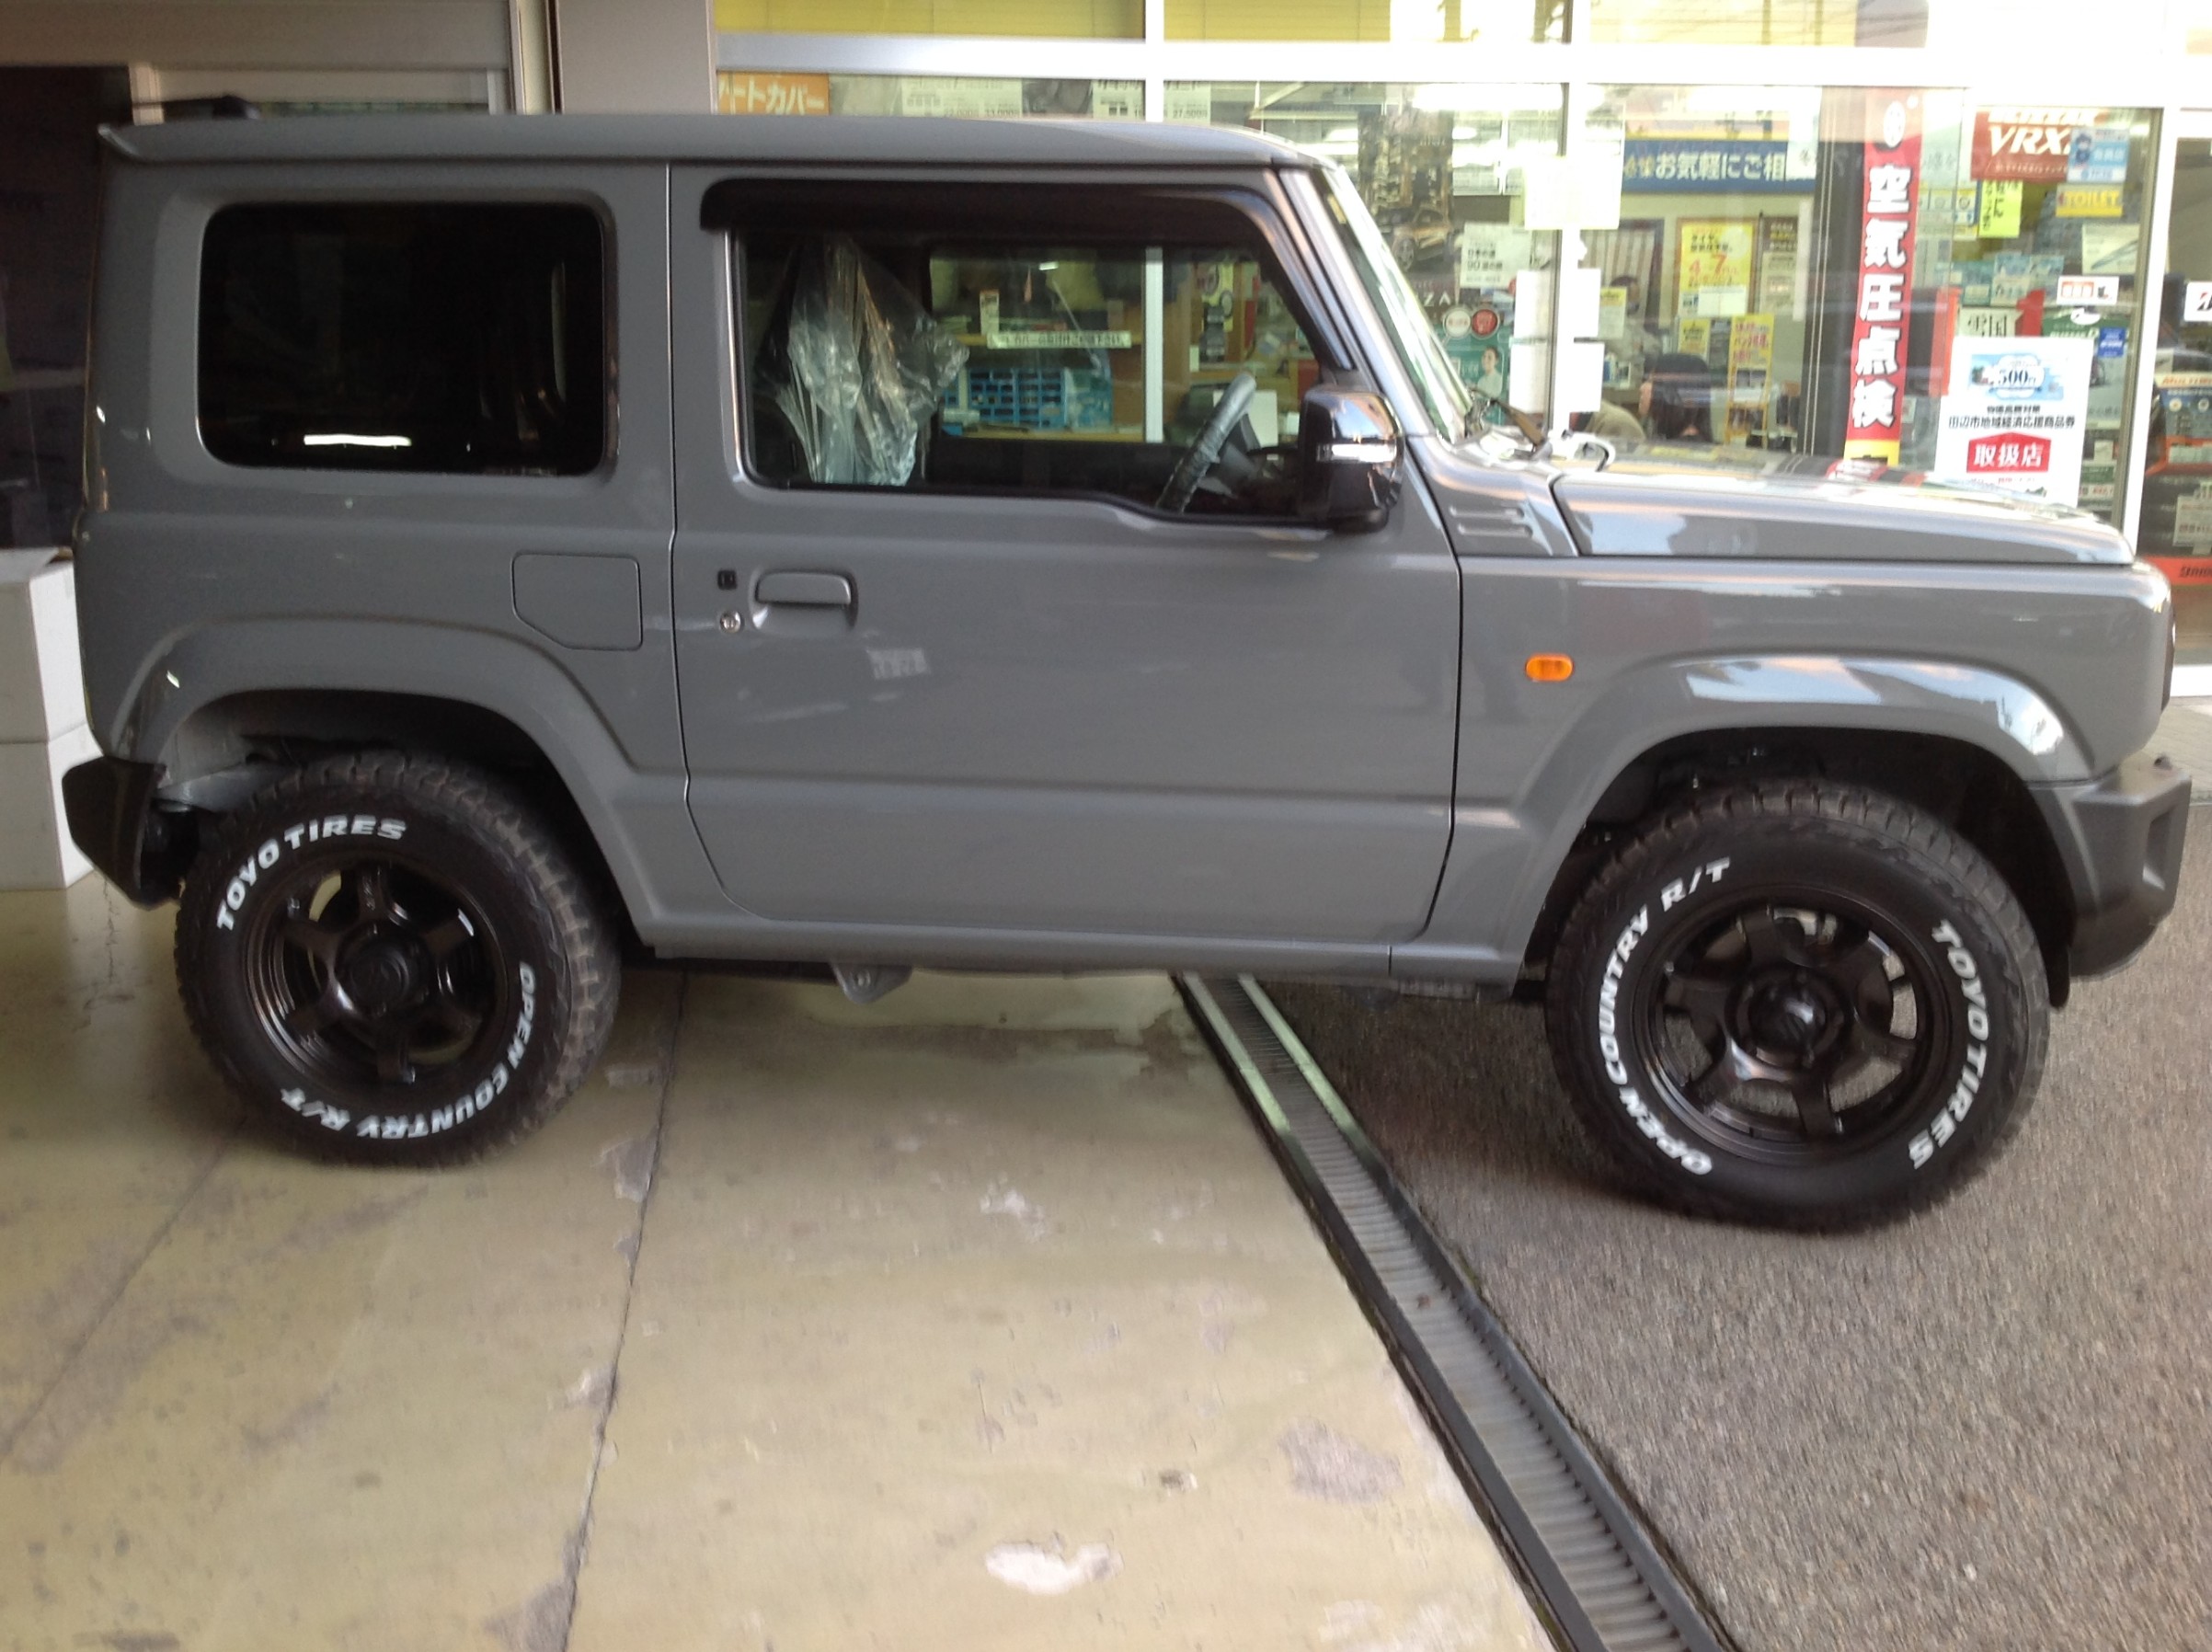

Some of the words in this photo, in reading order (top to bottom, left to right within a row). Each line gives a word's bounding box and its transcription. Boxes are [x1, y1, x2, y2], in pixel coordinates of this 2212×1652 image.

[2065, 190, 2120, 207] TOILET
[1851, 164, 1912, 429] 空気圧点検
[1973, 442, 2046, 468] 取扱店
[217, 839, 281, 930] TOYO
[284, 814, 406, 849] TIRES
[1660, 856, 1730, 912] R/T
[508, 961, 536, 1069] OPEN
[1598, 904, 1648, 1085] COUNTRY
[1932, 920, 1989, 1040] TOYO
[281, 1087, 350, 1131] R/T
[357, 1062, 509, 1139] COUNTRY
[1619, 1087, 1713, 1176] OPEN
[1908, 1042, 1987, 1169] TIRES
